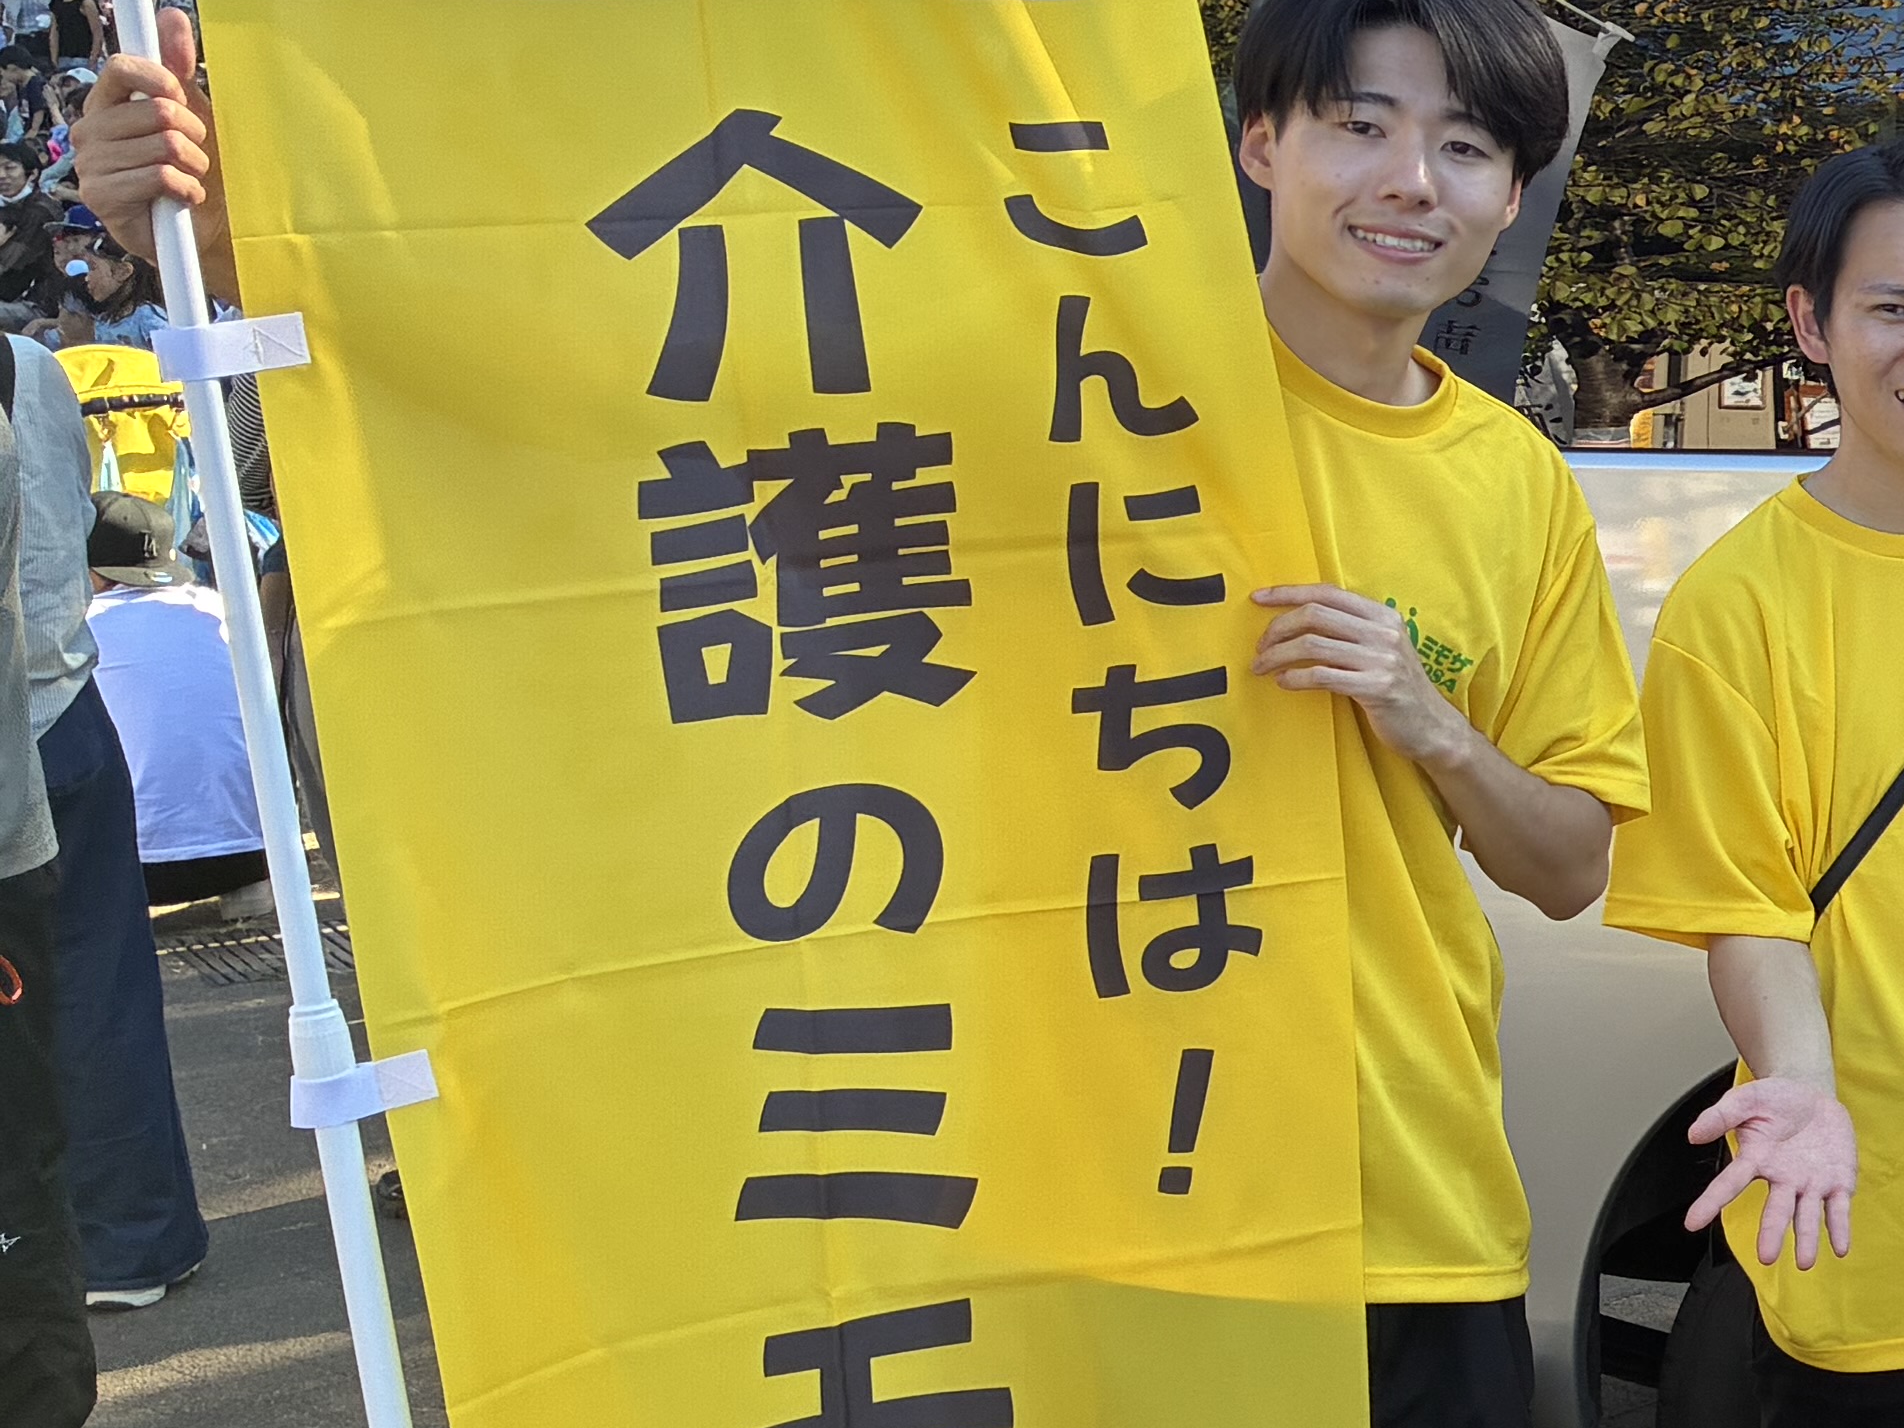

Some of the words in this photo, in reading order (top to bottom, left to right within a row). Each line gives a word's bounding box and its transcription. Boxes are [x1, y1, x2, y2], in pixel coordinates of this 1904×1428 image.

[1003, 118, 1263, 1196] こんにちは！
